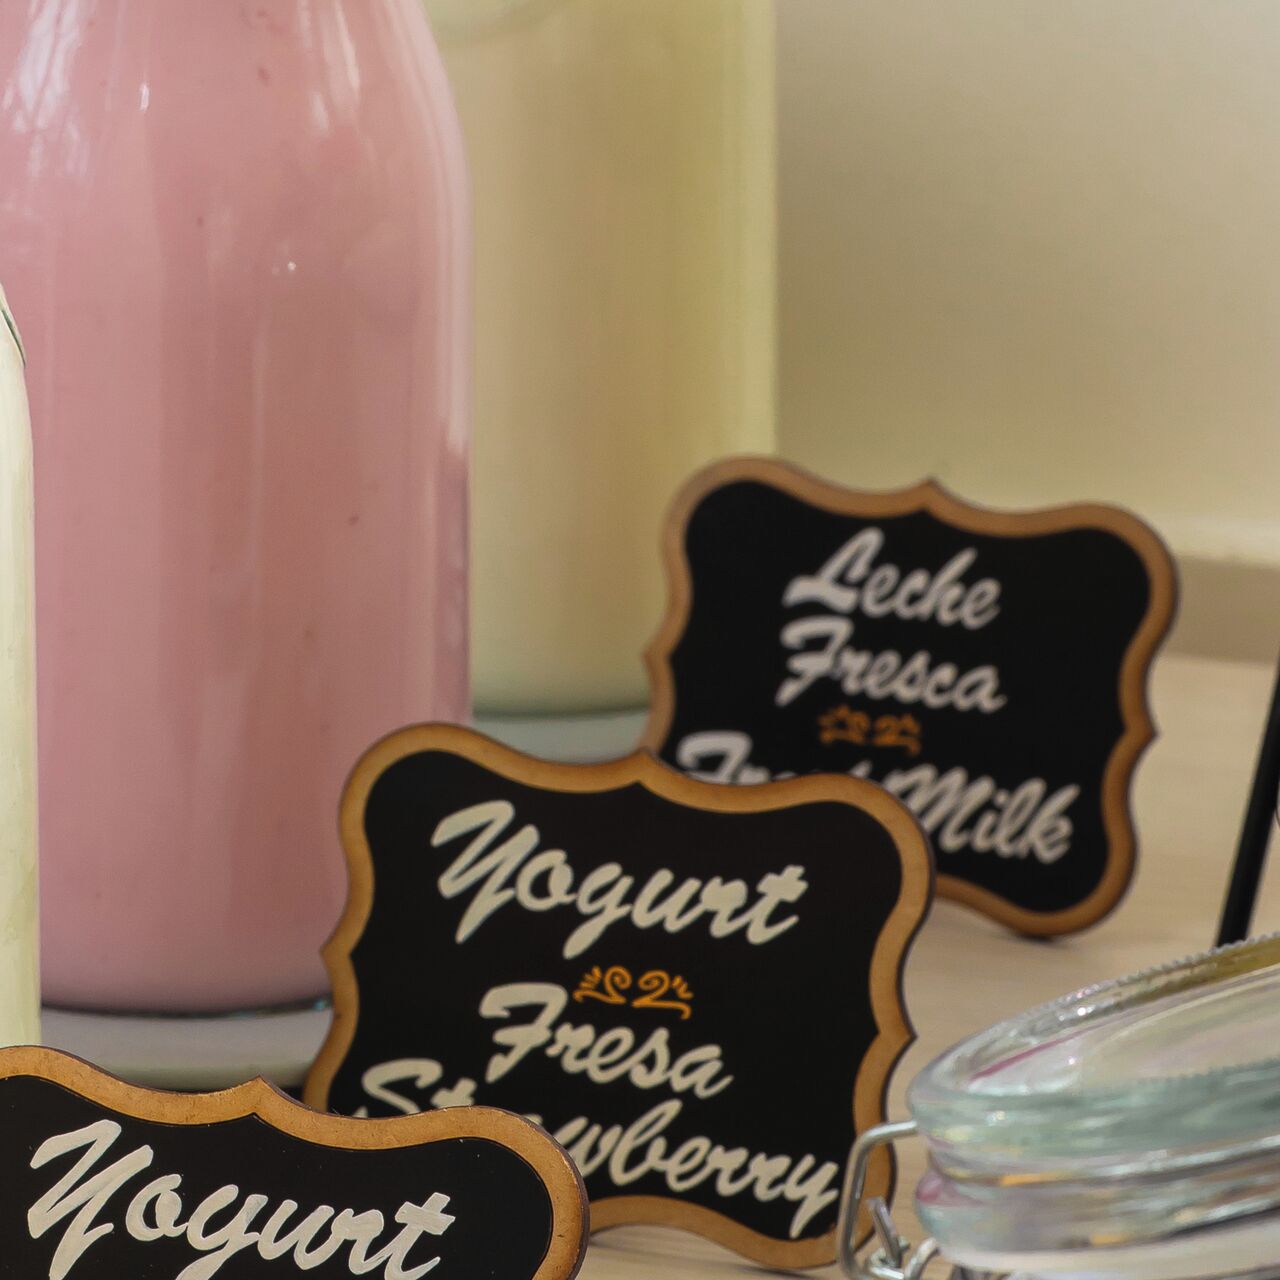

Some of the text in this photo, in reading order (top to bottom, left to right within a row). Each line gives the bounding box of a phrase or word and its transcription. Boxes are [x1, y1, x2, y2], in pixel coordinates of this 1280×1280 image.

[783, 527, 1001, 629] Leche
[776, 616, 1007, 712] Fresca
[882, 765, 1080, 863] Milk
[431, 800, 808, 959] Yogurt
[479, 982, 734, 1098] Fresa
